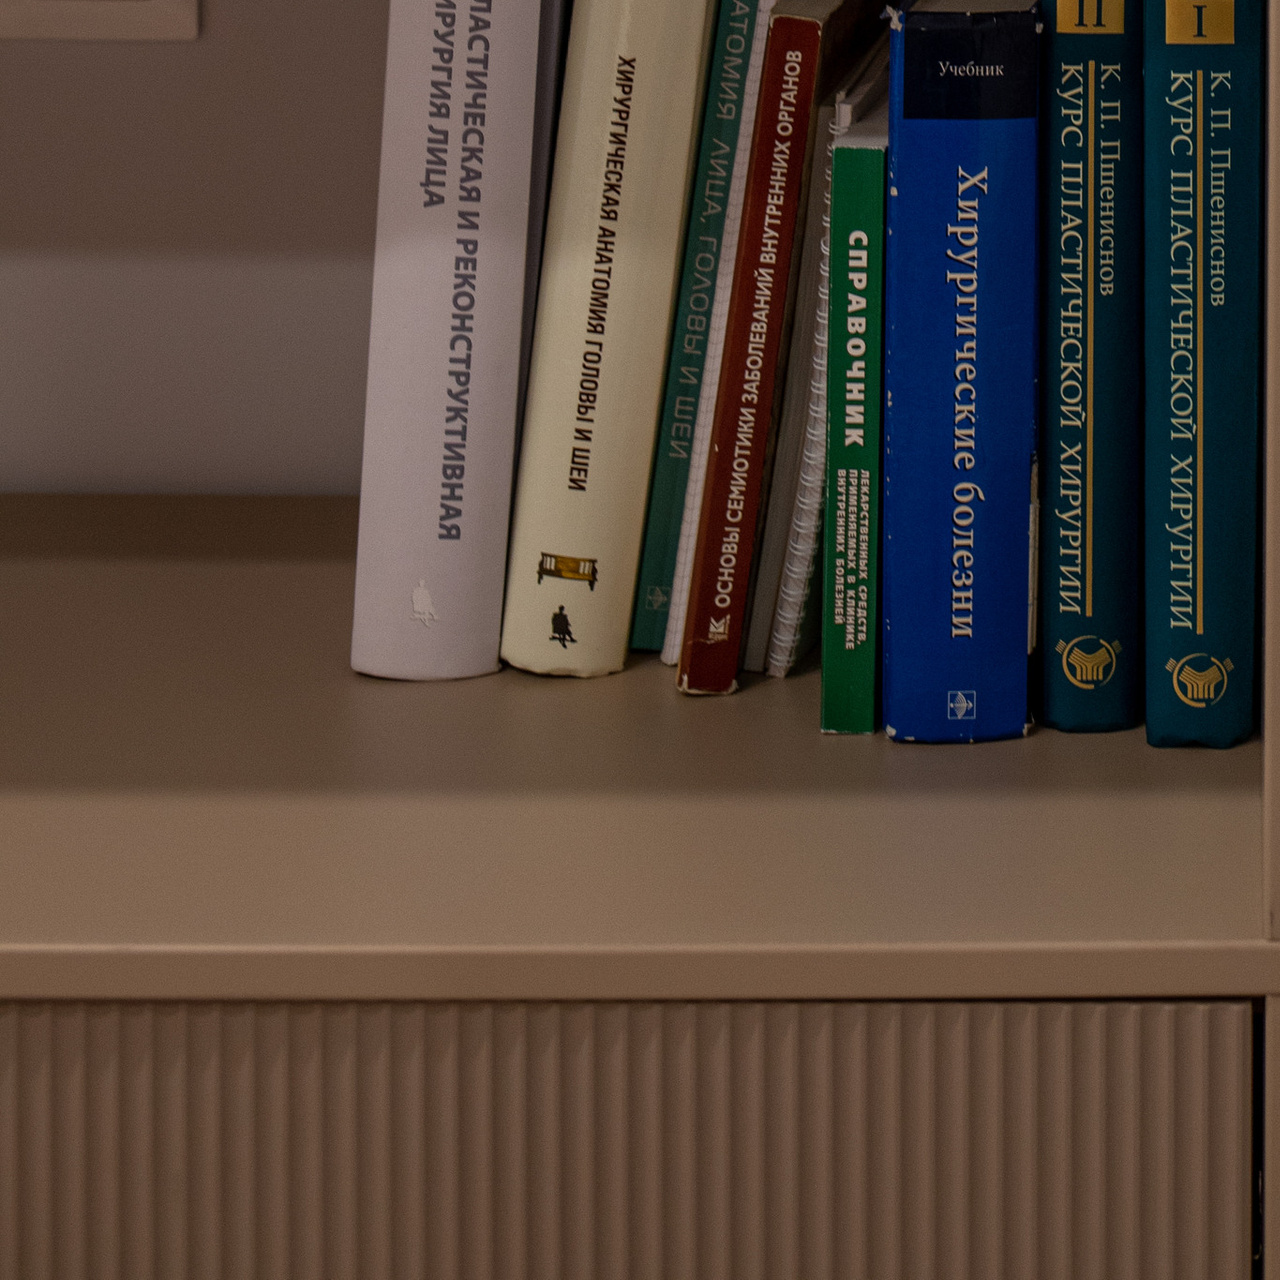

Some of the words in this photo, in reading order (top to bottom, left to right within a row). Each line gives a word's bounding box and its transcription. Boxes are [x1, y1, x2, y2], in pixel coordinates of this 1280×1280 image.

[1192, 5, 1207, 38] I
[776, 49, 802, 136] ОРГАНОВ
[938, 60, 1005, 77] Учебник
[1056, 62, 1084, 147] КУРС
[1100, 63, 1121, 90] К.
[1210, 71, 1231, 98] К.
[600, 55, 636, 222] ХИРУРГИЧЕСКАЯ
[1100, 99, 1121, 130] П.
[1165, 71, 1193, 156] КУРС
[1210, 108, 1231, 138] П.
[420, 124, 449, 209] ЛИЦА
[700, 137, 731, 222] ЛИЦА,
[760, 140, 791, 264] ВНУТРЕННИХ
[457, 211, 479, 231] И
[1100, 139, 1121, 297] Пшениснов
[1210, 148, 1231, 307] Пшениснов
[587, 224, 616, 335] АНАТОМИЯ
[684, 236, 717, 355] ГОЛОВЫ
[946, 165, 988, 470] Хирургические
[1060, 160, 1086, 429] ПЛАСТИЧЕСКОЙ
[1170, 169, 1197, 441] ПЛАСТИЧЕСКОЙ
[679, 365, 698, 386] И
[741, 264, 775, 404] ЗАБОЛЕВАНИЙ
[844, 229, 868, 448] СПРАВОЧНИК
[438, 237, 478, 541] РЕКОНСТРУКТИВНАЯ
[576, 339, 602, 423] ГОЛОВЫ
[568, 446, 591, 492] ШЕИ
[574, 428, 592, 443] И
[669, 397, 697, 460] ШЕИ
[727, 406, 756, 523] СЕМИОТИКИ
[836, 468, 846, 553] ВНУТРЕННИХ
[847, 468, 858, 569] ПРИМЕНЯЕМЫХ
[858, 469, 870, 580] ЛЕКАРСТВЕННЫХ
[1055, 441, 1082, 615] ХИРУРГИИ
[1165, 455, 1192, 630] ХИРУРГИИ
[714, 523, 741, 608] ОСНОВЫ
[834, 558, 846, 625] БОЛЕЗНЕЙ
[846, 575, 856, 584] В
[951, 481, 985, 638] болезни
[845, 589, 856, 650] КЛИНИКЕ
